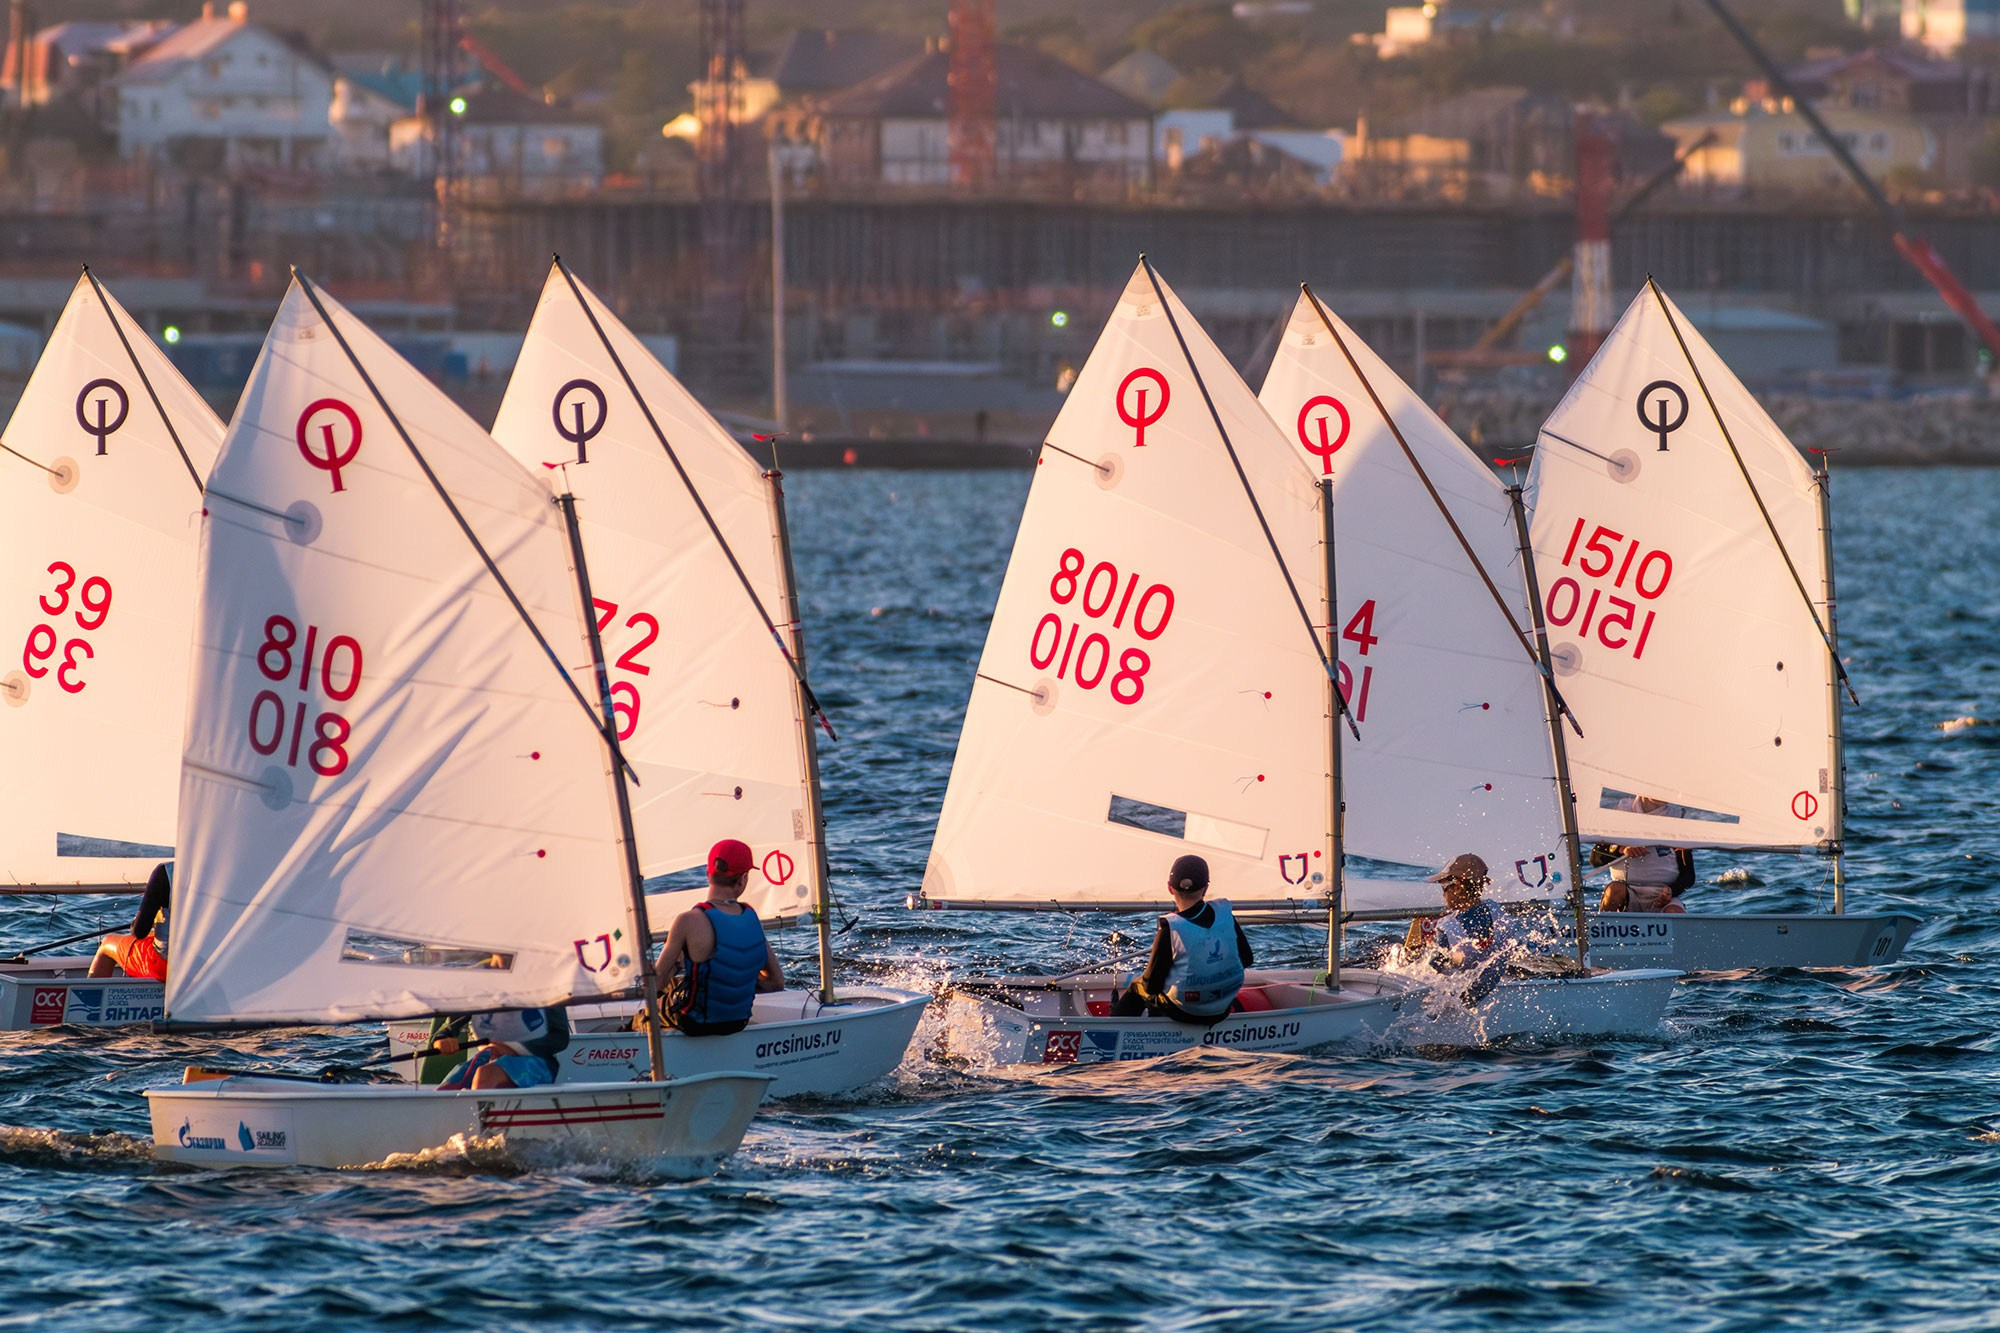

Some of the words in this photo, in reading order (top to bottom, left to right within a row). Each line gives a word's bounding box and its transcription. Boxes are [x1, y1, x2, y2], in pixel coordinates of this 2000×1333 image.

[1561, 517, 1673, 600] 1510
[39, 561, 112, 630] 39
[1050, 548, 1175, 641] 8010
[257, 614, 363, 702] 810
[1873, 937, 1892, 957] 101
[757, 1029, 841, 1058] arcsinus.ru
[1203, 1022, 1300, 1045] arcsinus.ru
[588, 1048, 639, 1060] FAREAST
[256, 1131, 286, 1141] SAILING
